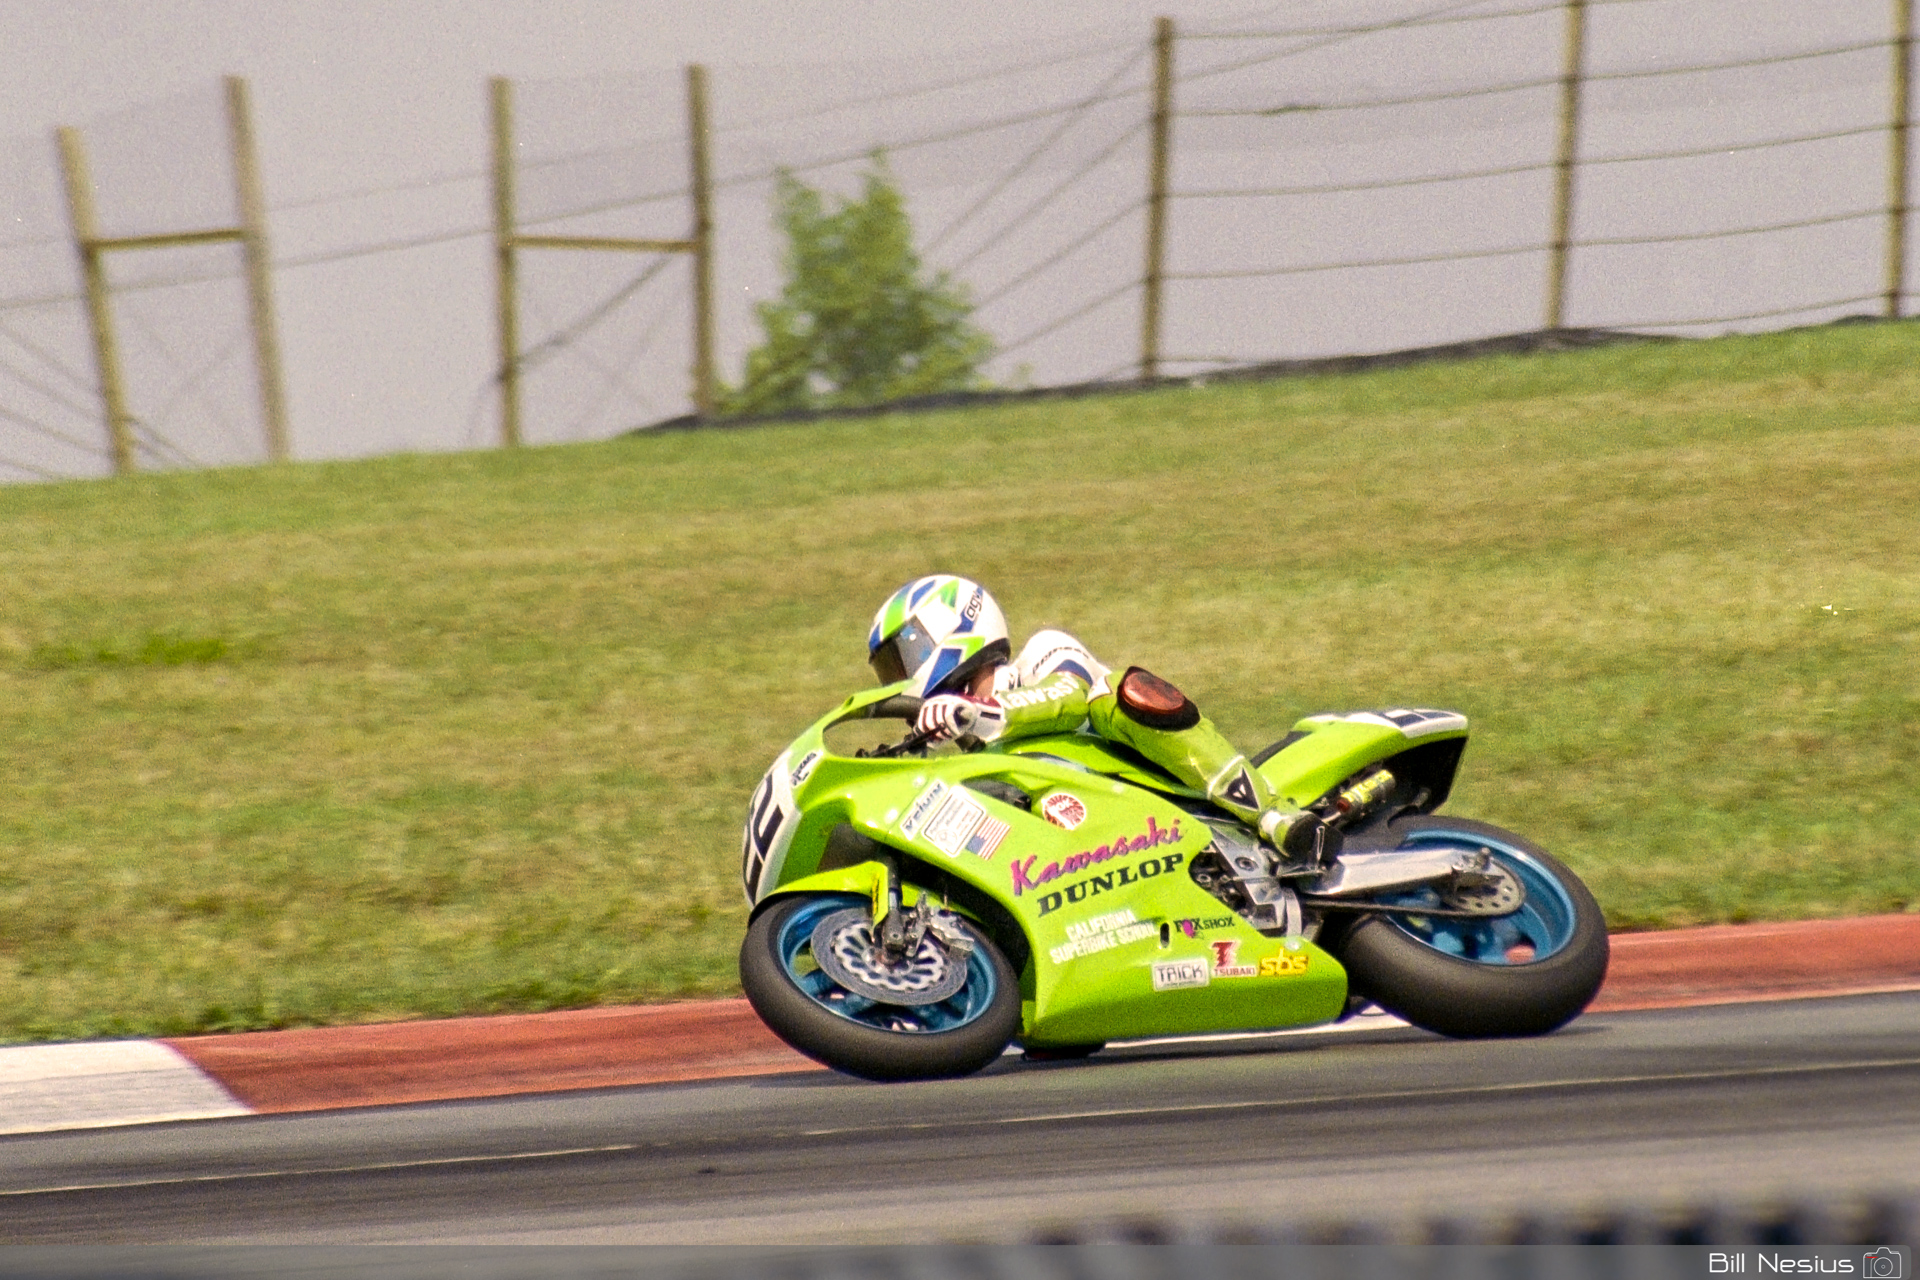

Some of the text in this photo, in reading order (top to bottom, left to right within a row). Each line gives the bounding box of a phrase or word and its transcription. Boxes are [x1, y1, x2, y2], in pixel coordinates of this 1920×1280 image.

[1010, 816, 1183, 897] Kawasaki
[1037, 853, 1184, 917] DUNLOP
[1066, 908, 1137, 941] CALIFORNIA
[1050, 930, 1119, 964] SUPERBIKE
[1260, 947, 1309, 976] sbs
[1156, 964, 1205, 984] TRICK
